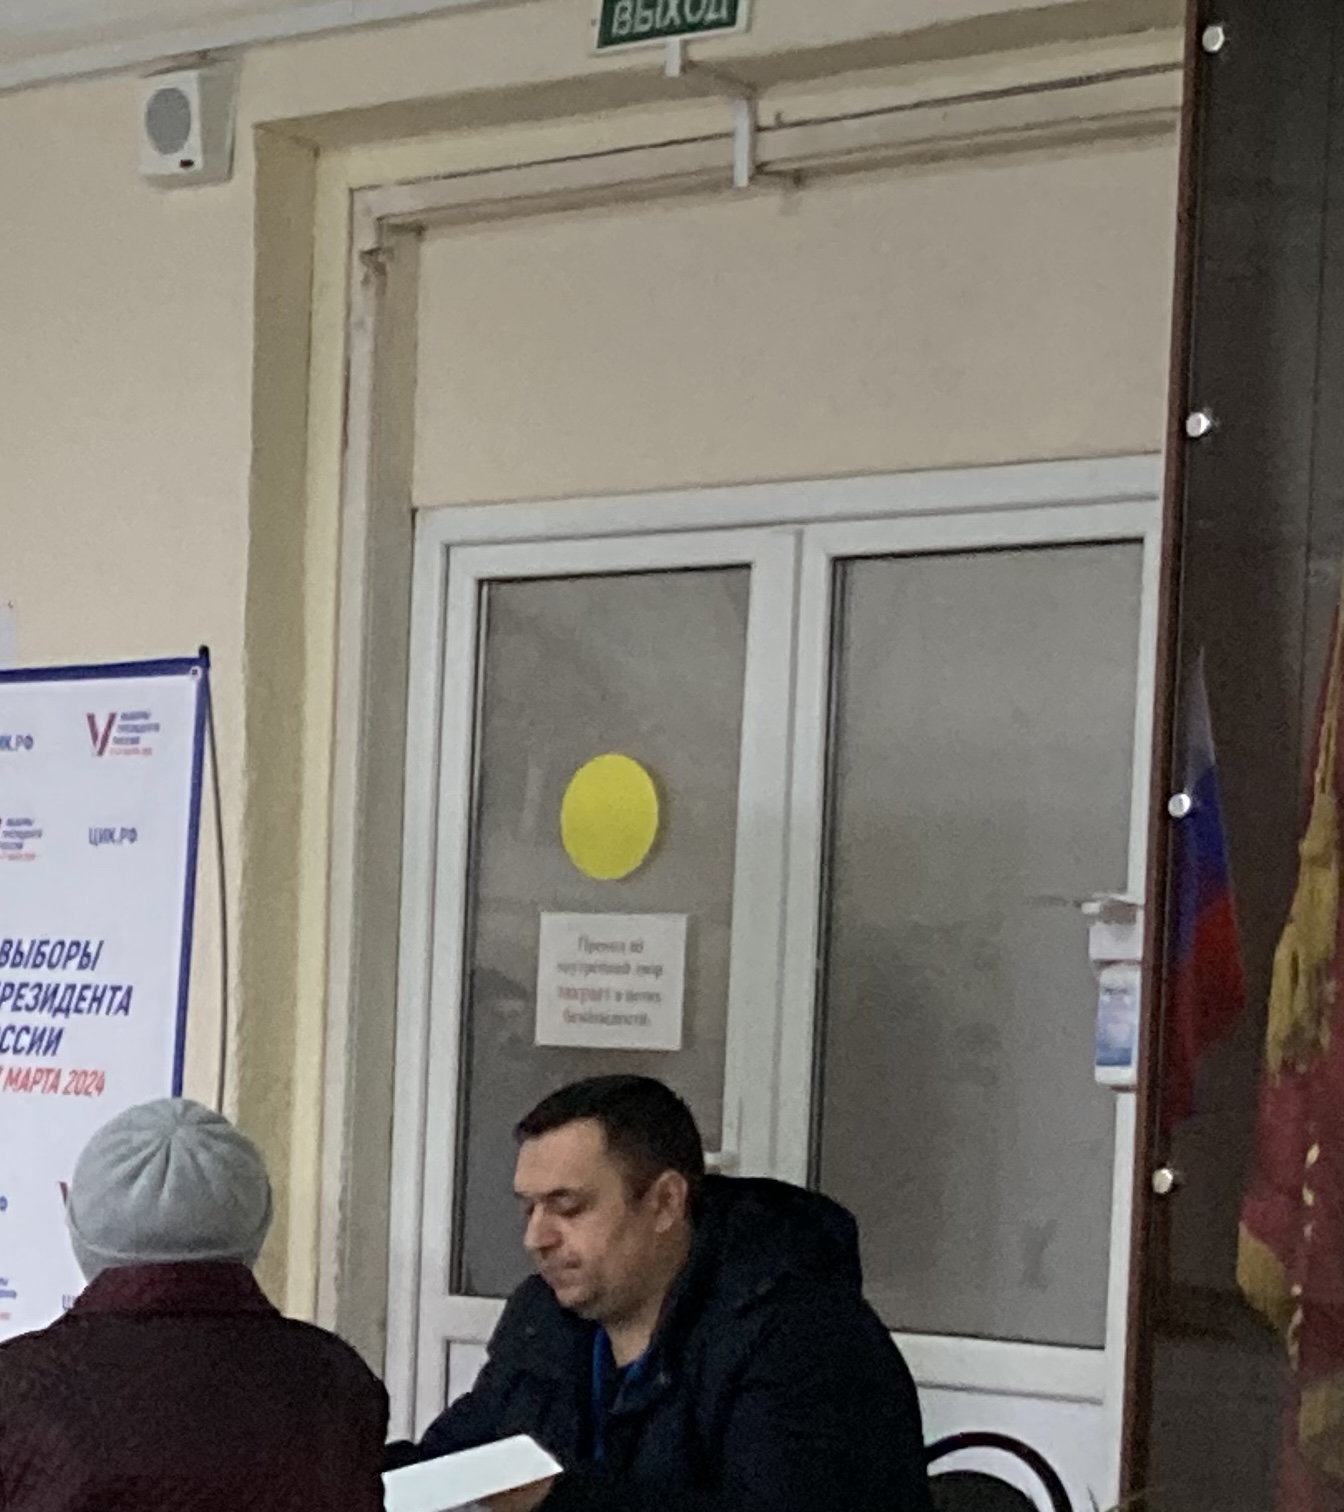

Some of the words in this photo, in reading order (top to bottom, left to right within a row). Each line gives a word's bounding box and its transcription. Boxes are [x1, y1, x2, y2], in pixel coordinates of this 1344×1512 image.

[613, 0, 728, 34] ВЫХОД
[2, 1066, 62, 1095] МАРТА
[62, 1070, 106, 1096] 2024
